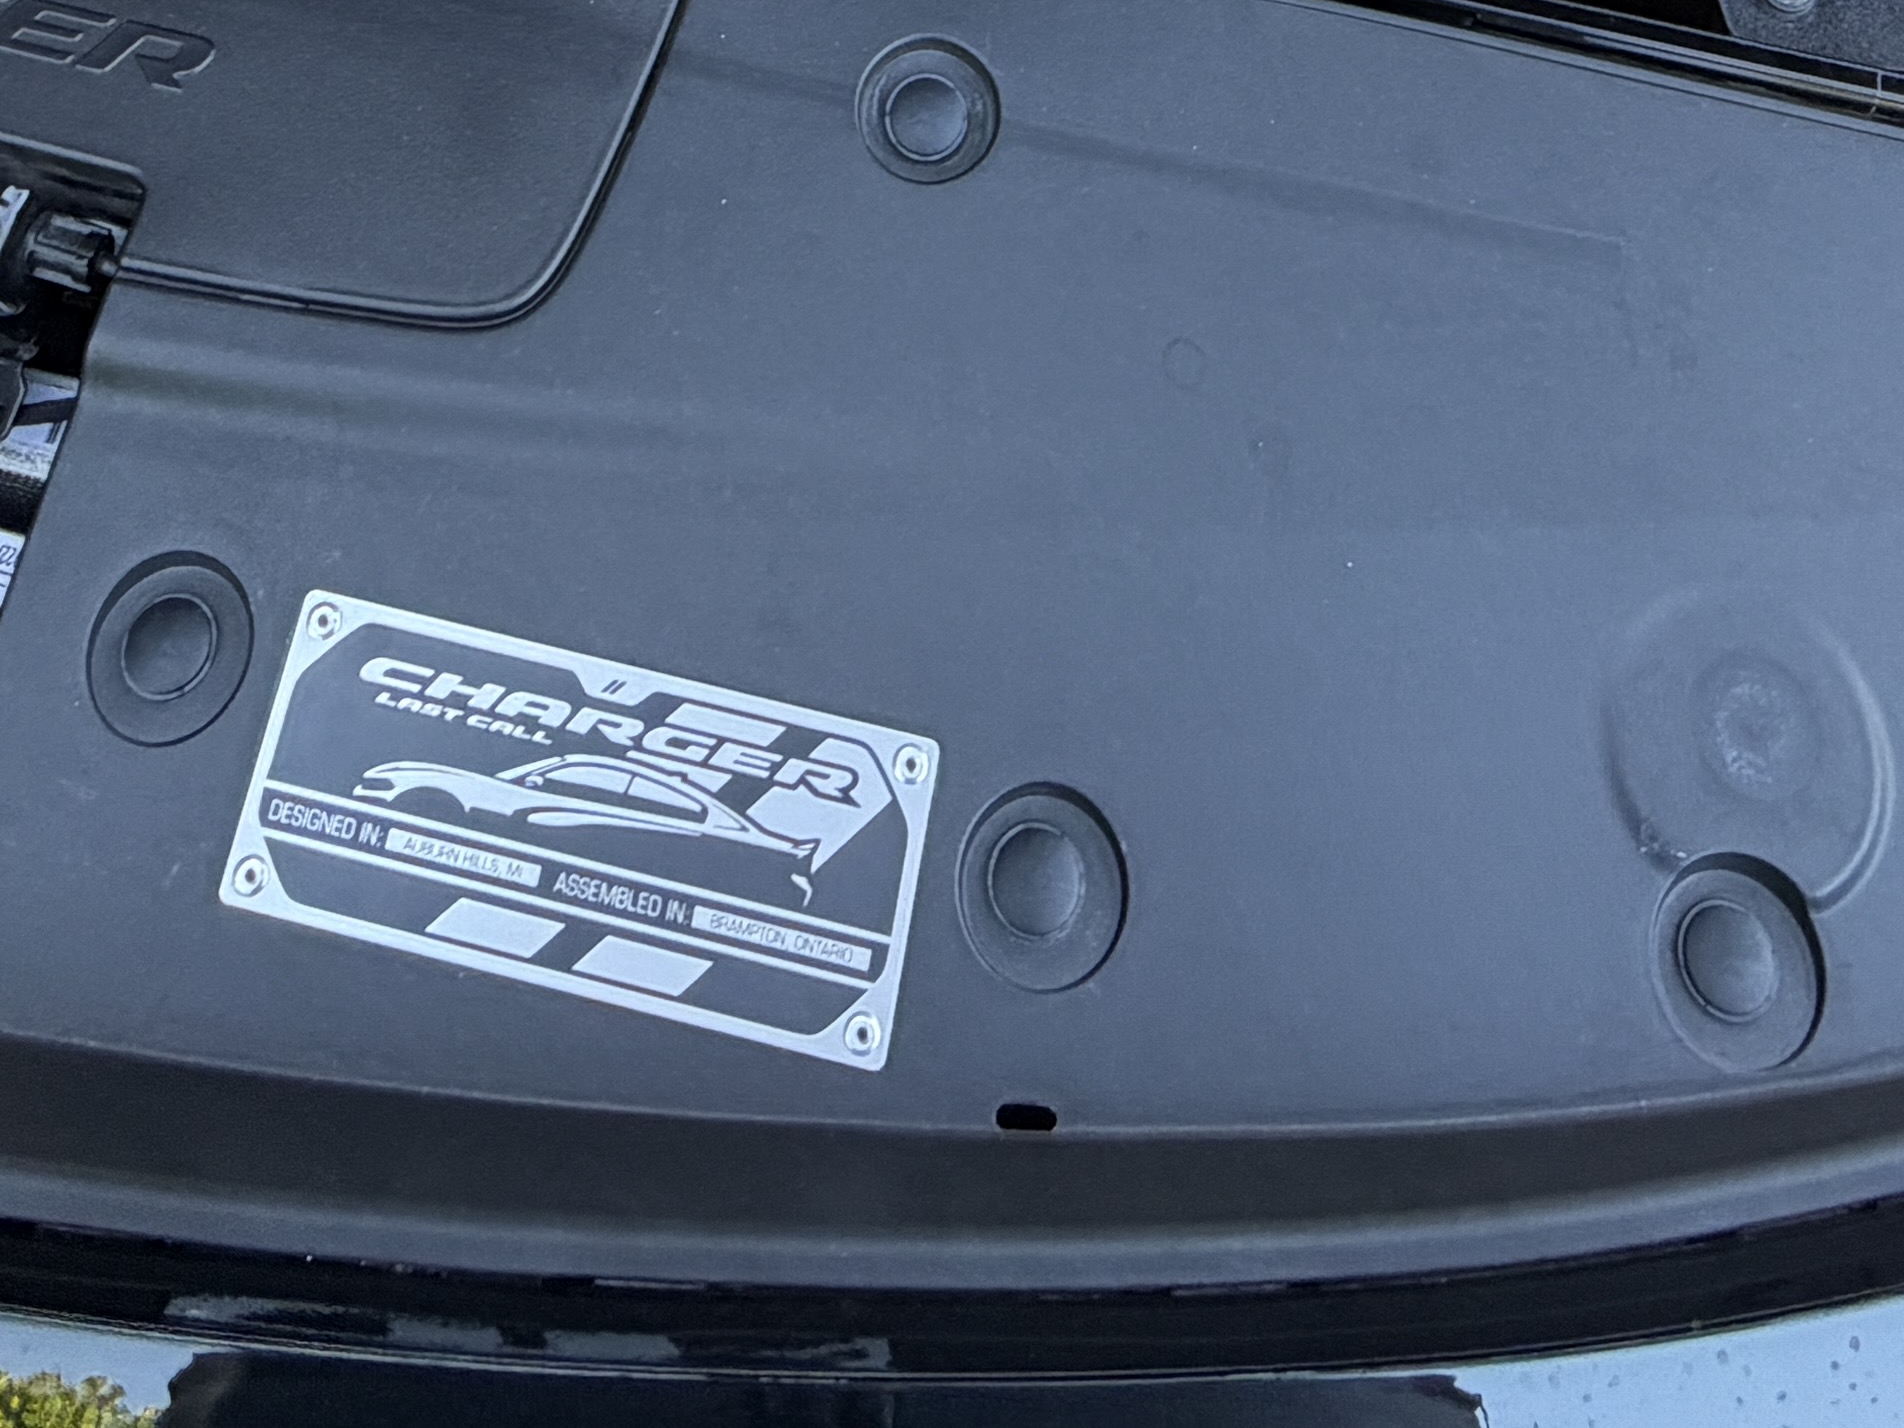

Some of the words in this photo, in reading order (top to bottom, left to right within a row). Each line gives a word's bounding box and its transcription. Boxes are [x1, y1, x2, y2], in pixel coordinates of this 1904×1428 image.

[358, 656, 861, 808] CHARGER
[374, 692, 465, 723] LAST
[466, 714, 553, 745] CALL
[267, 798, 357, 842] DESIGNED
[358, 820, 385, 849] IN:
[552, 871, 662, 918] ASSEMBLED
[664, 900, 693, 926] IN:
[794, 932, 855, 965] ONTARIO
